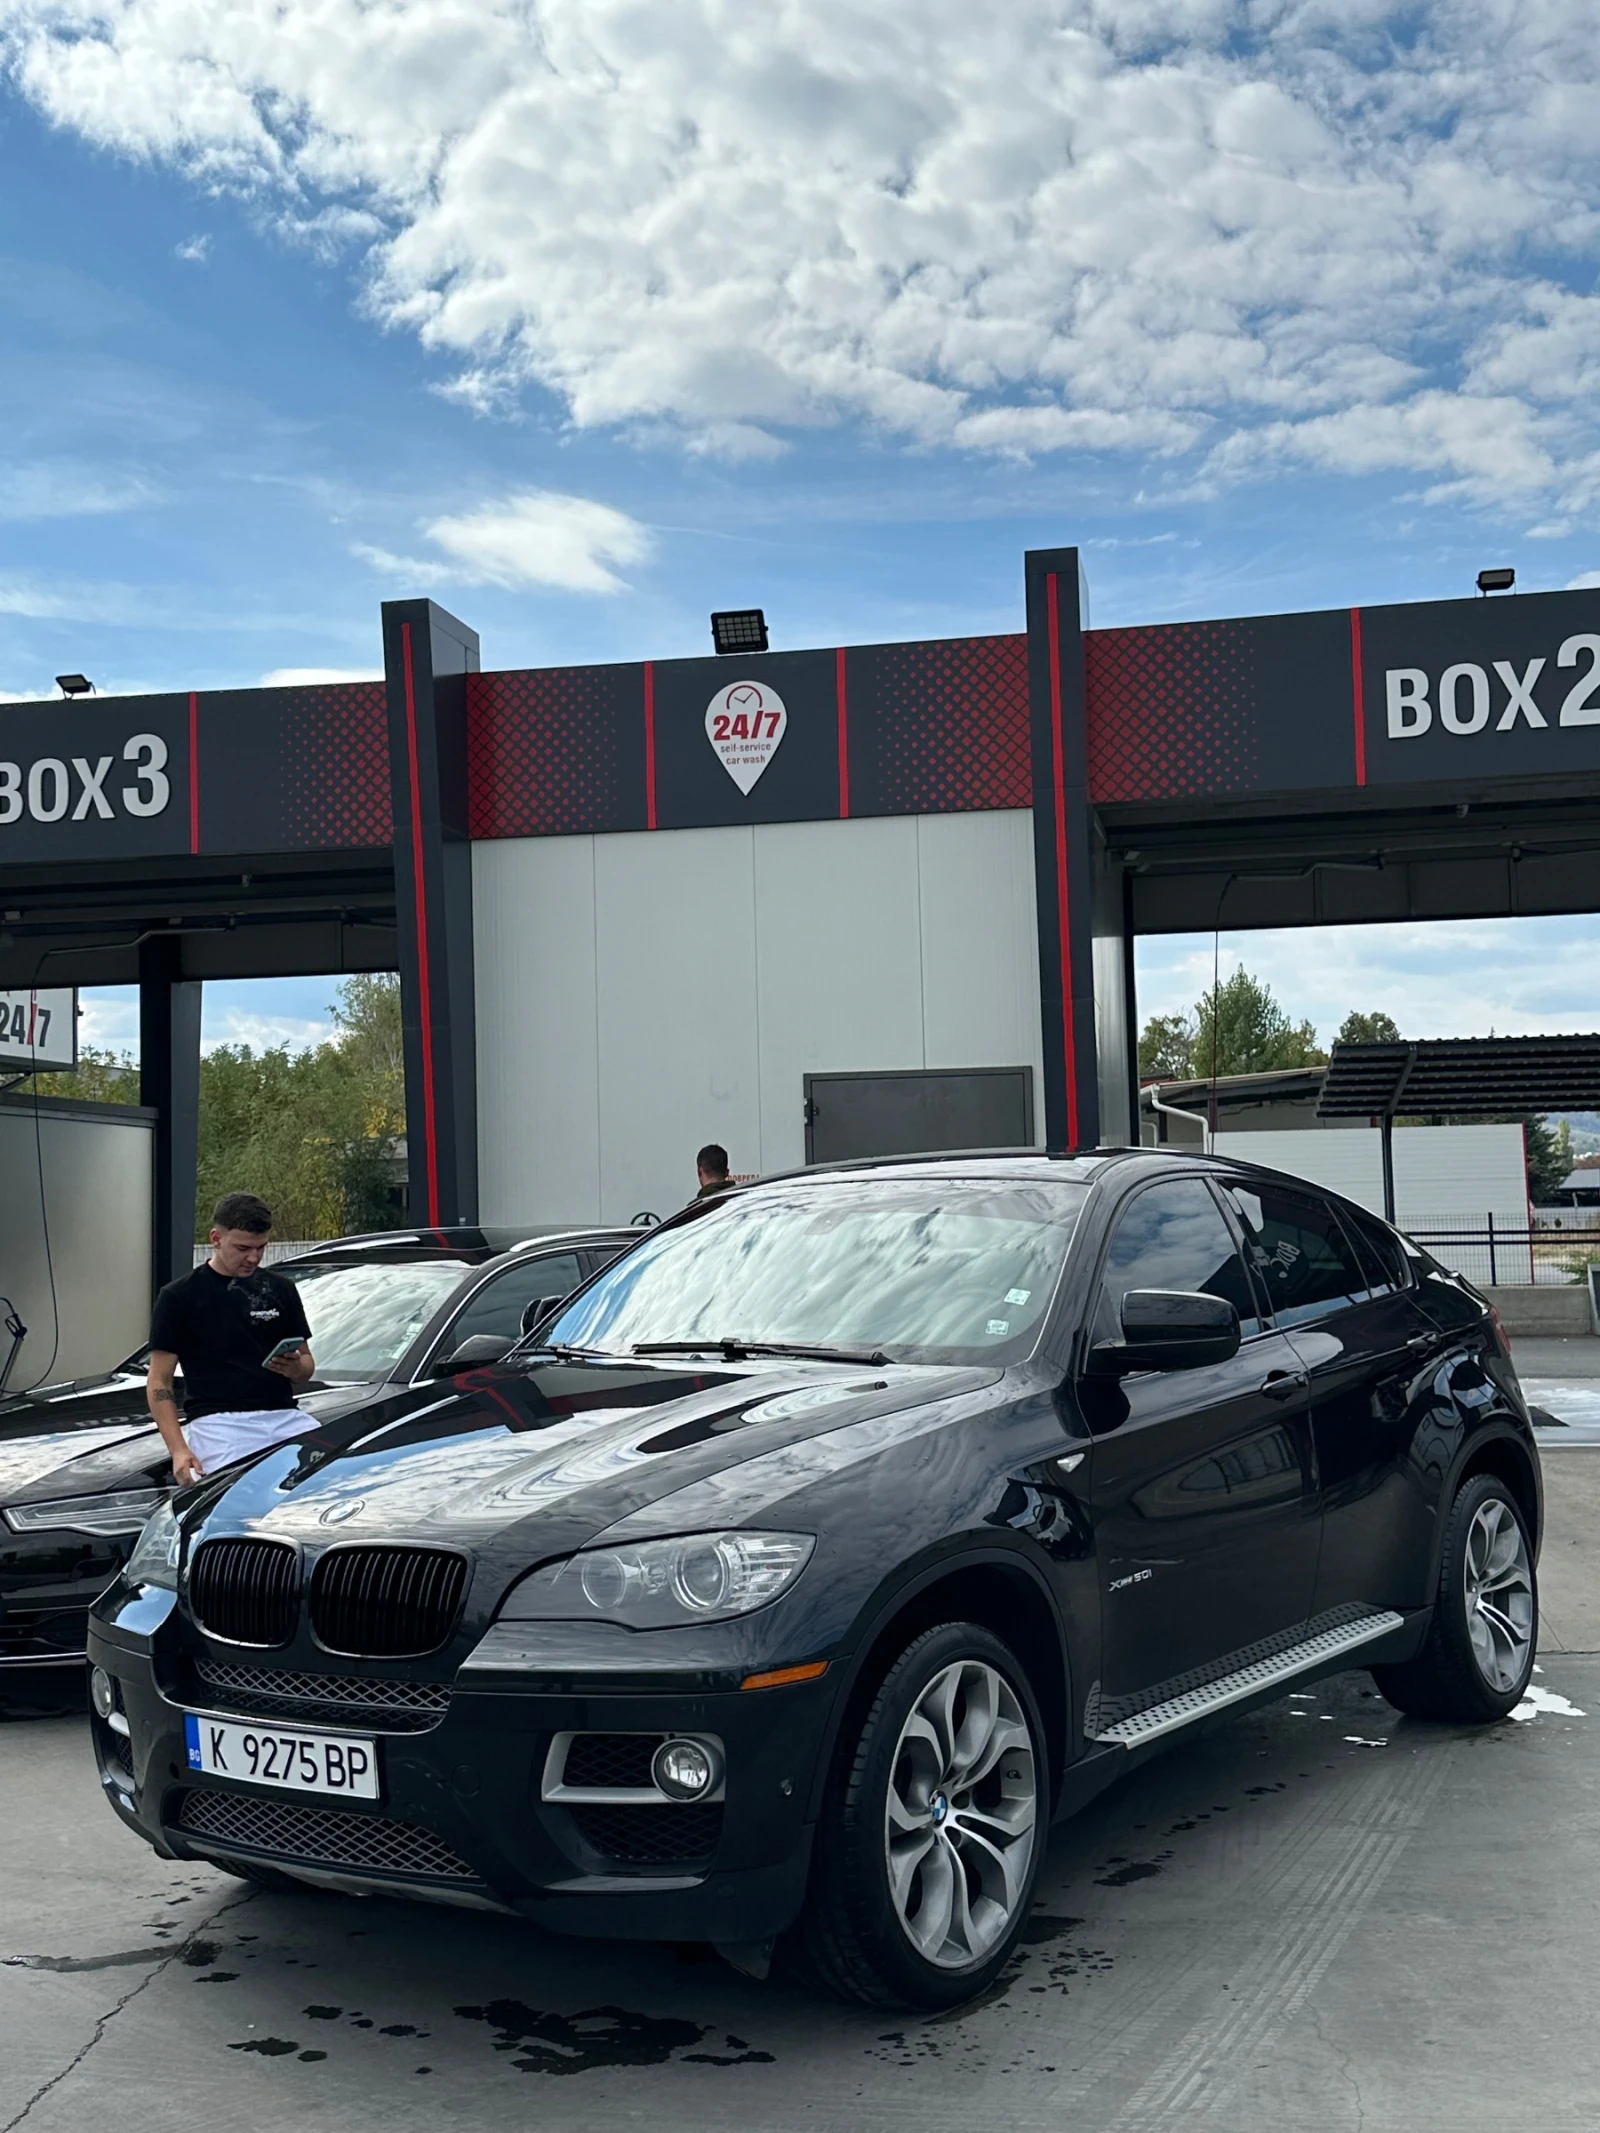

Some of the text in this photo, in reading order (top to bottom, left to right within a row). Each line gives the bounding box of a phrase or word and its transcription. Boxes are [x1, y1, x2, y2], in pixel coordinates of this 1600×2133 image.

[713, 710, 781, 741] 24/7
[720, 742, 771, 753] self-service
[726, 755, 766, 765] car wash
[0, 1001, 51, 1048] 24/7
[189, 1748, 200, 1761] BG
[210, 1727, 229, 1771] K
